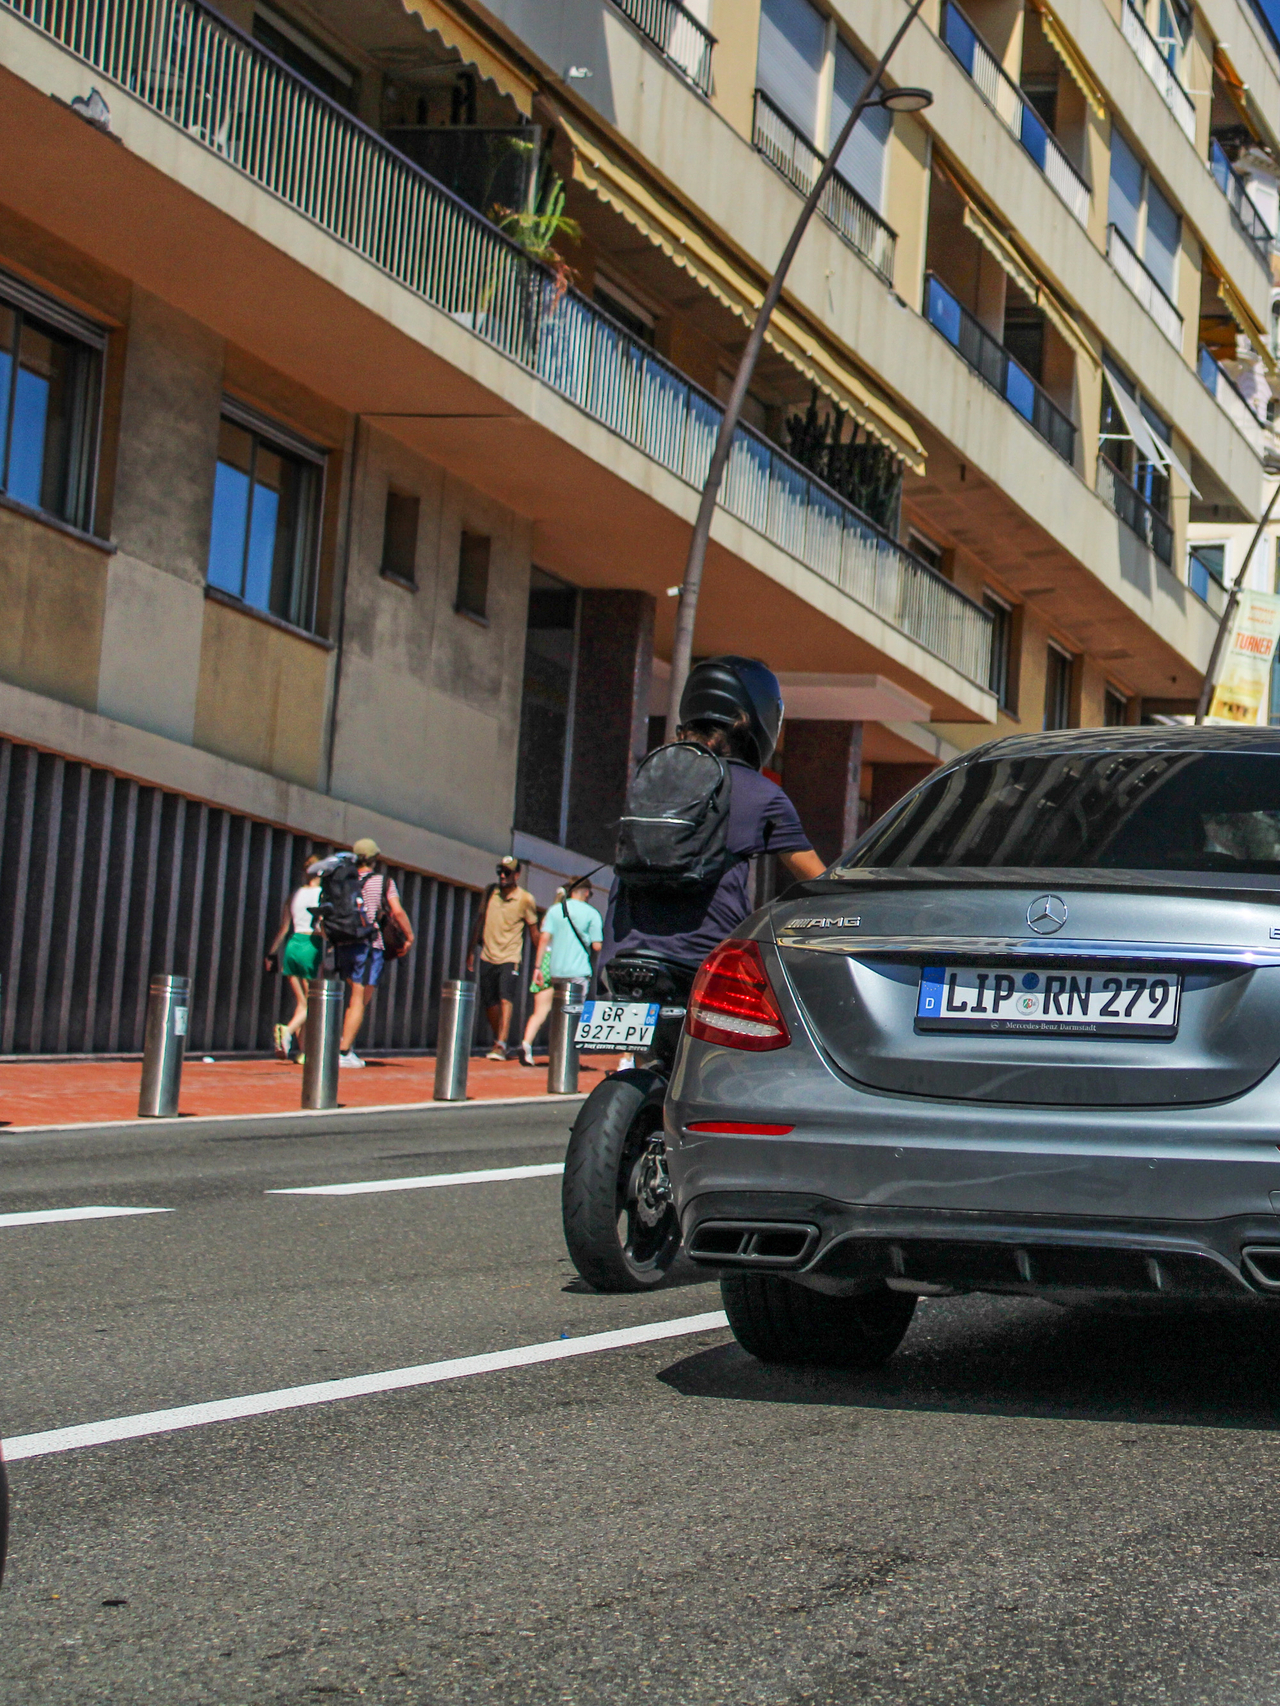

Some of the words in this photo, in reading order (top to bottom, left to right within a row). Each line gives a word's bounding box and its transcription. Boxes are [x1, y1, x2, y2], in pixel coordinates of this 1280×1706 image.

[1235, 632, 1273, 656] TURNER
[807, 917, 861, 928] AMG
[946, 972, 1015, 1014] LIP
[1043, 976, 1093, 1016] RN
[1100, 977, 1169, 1019] 279
[925, 998, 935, 1009] D
[645, 1016, 655, 1024] 06
[1006, 1021, 1058, 1031] Mercedes-Benz
[1060, 1023, 1097, 1032] Darmstadt
[580, 1024, 649, 1042] 927-PV
